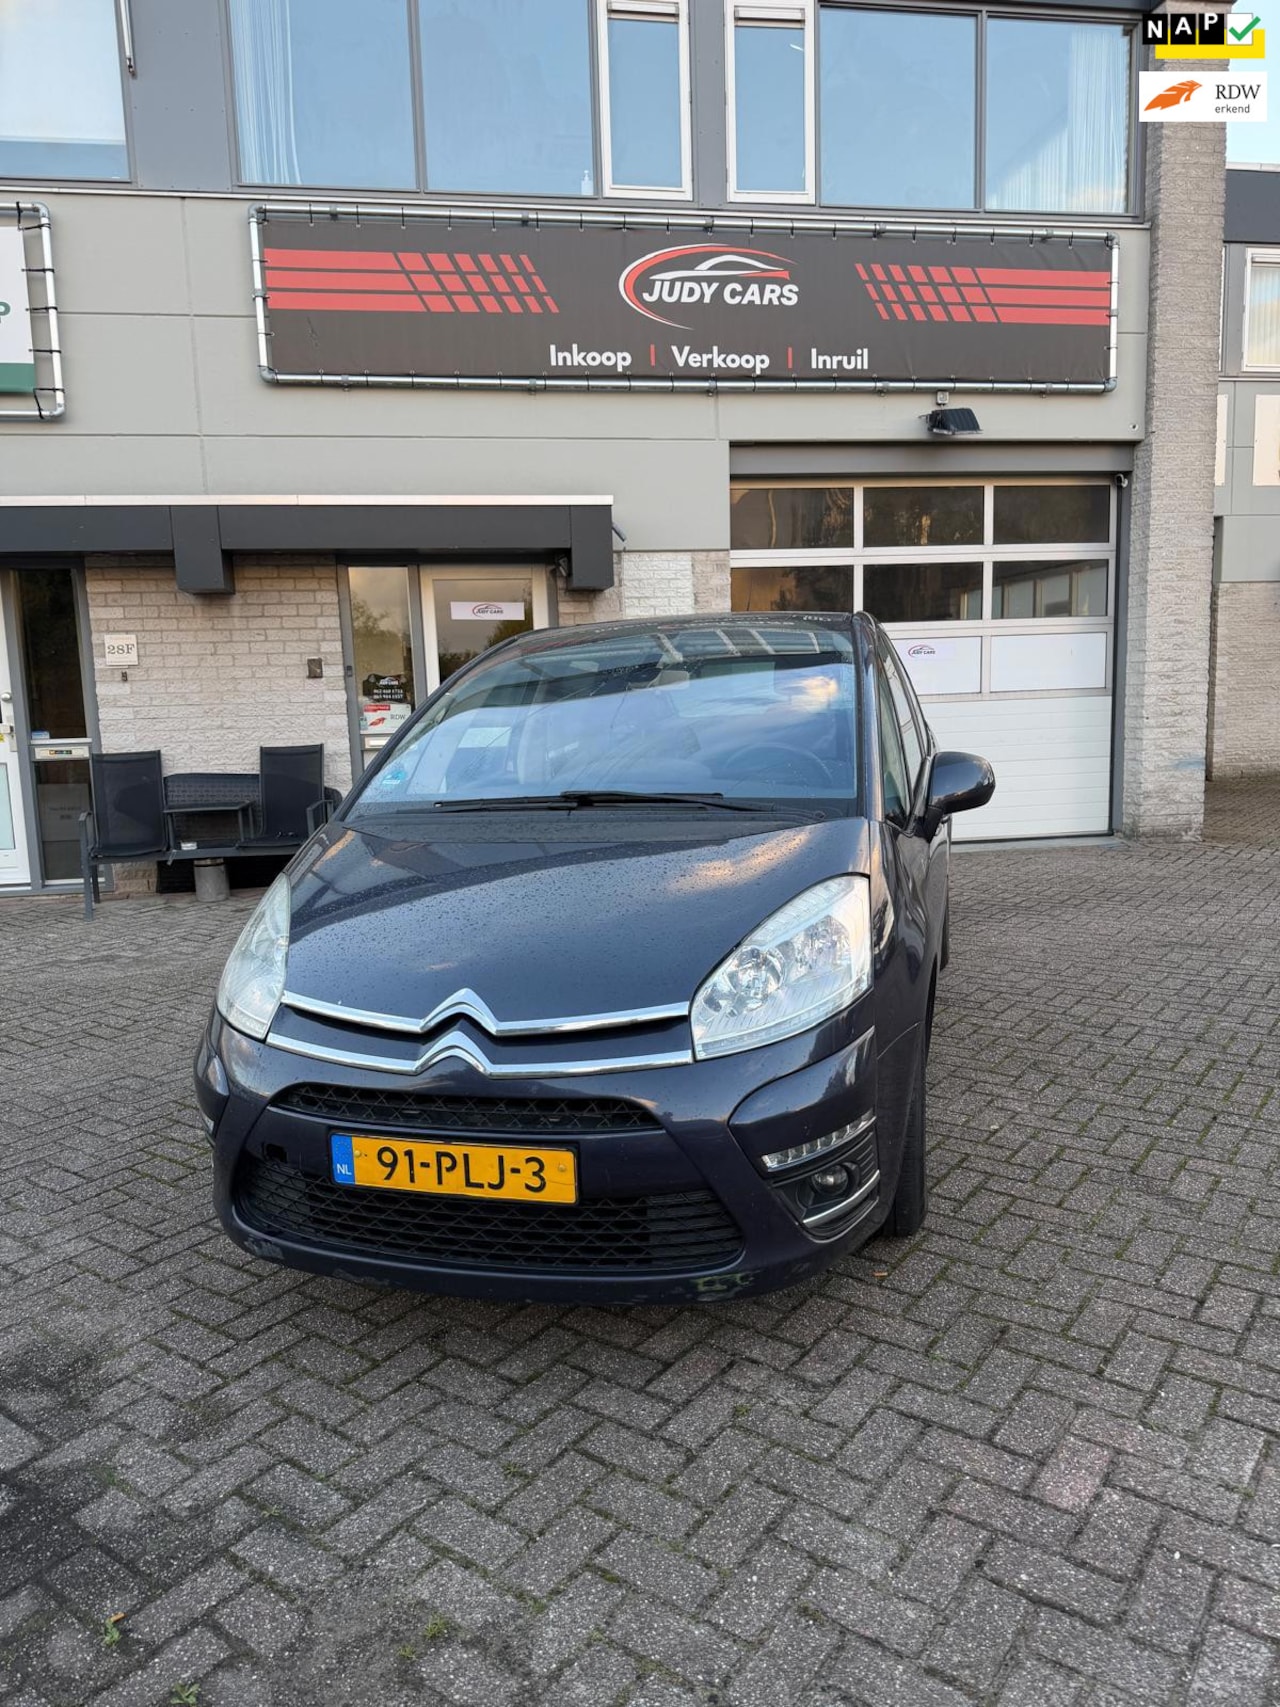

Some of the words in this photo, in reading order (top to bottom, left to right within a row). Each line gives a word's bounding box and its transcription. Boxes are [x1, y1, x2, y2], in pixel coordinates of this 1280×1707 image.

[642, 280, 719, 304] JUDY
[723, 282, 799, 306] CARS
[550, 343, 632, 372] Inkoop
[671, 345, 770, 375] Verkoop
[811, 348, 869, 370] Inruil
[107, 643, 135, 655] 28F
[337, 1163, 352, 1176] NL
[377, 1146, 547, 1193] 91-PLJ-3
